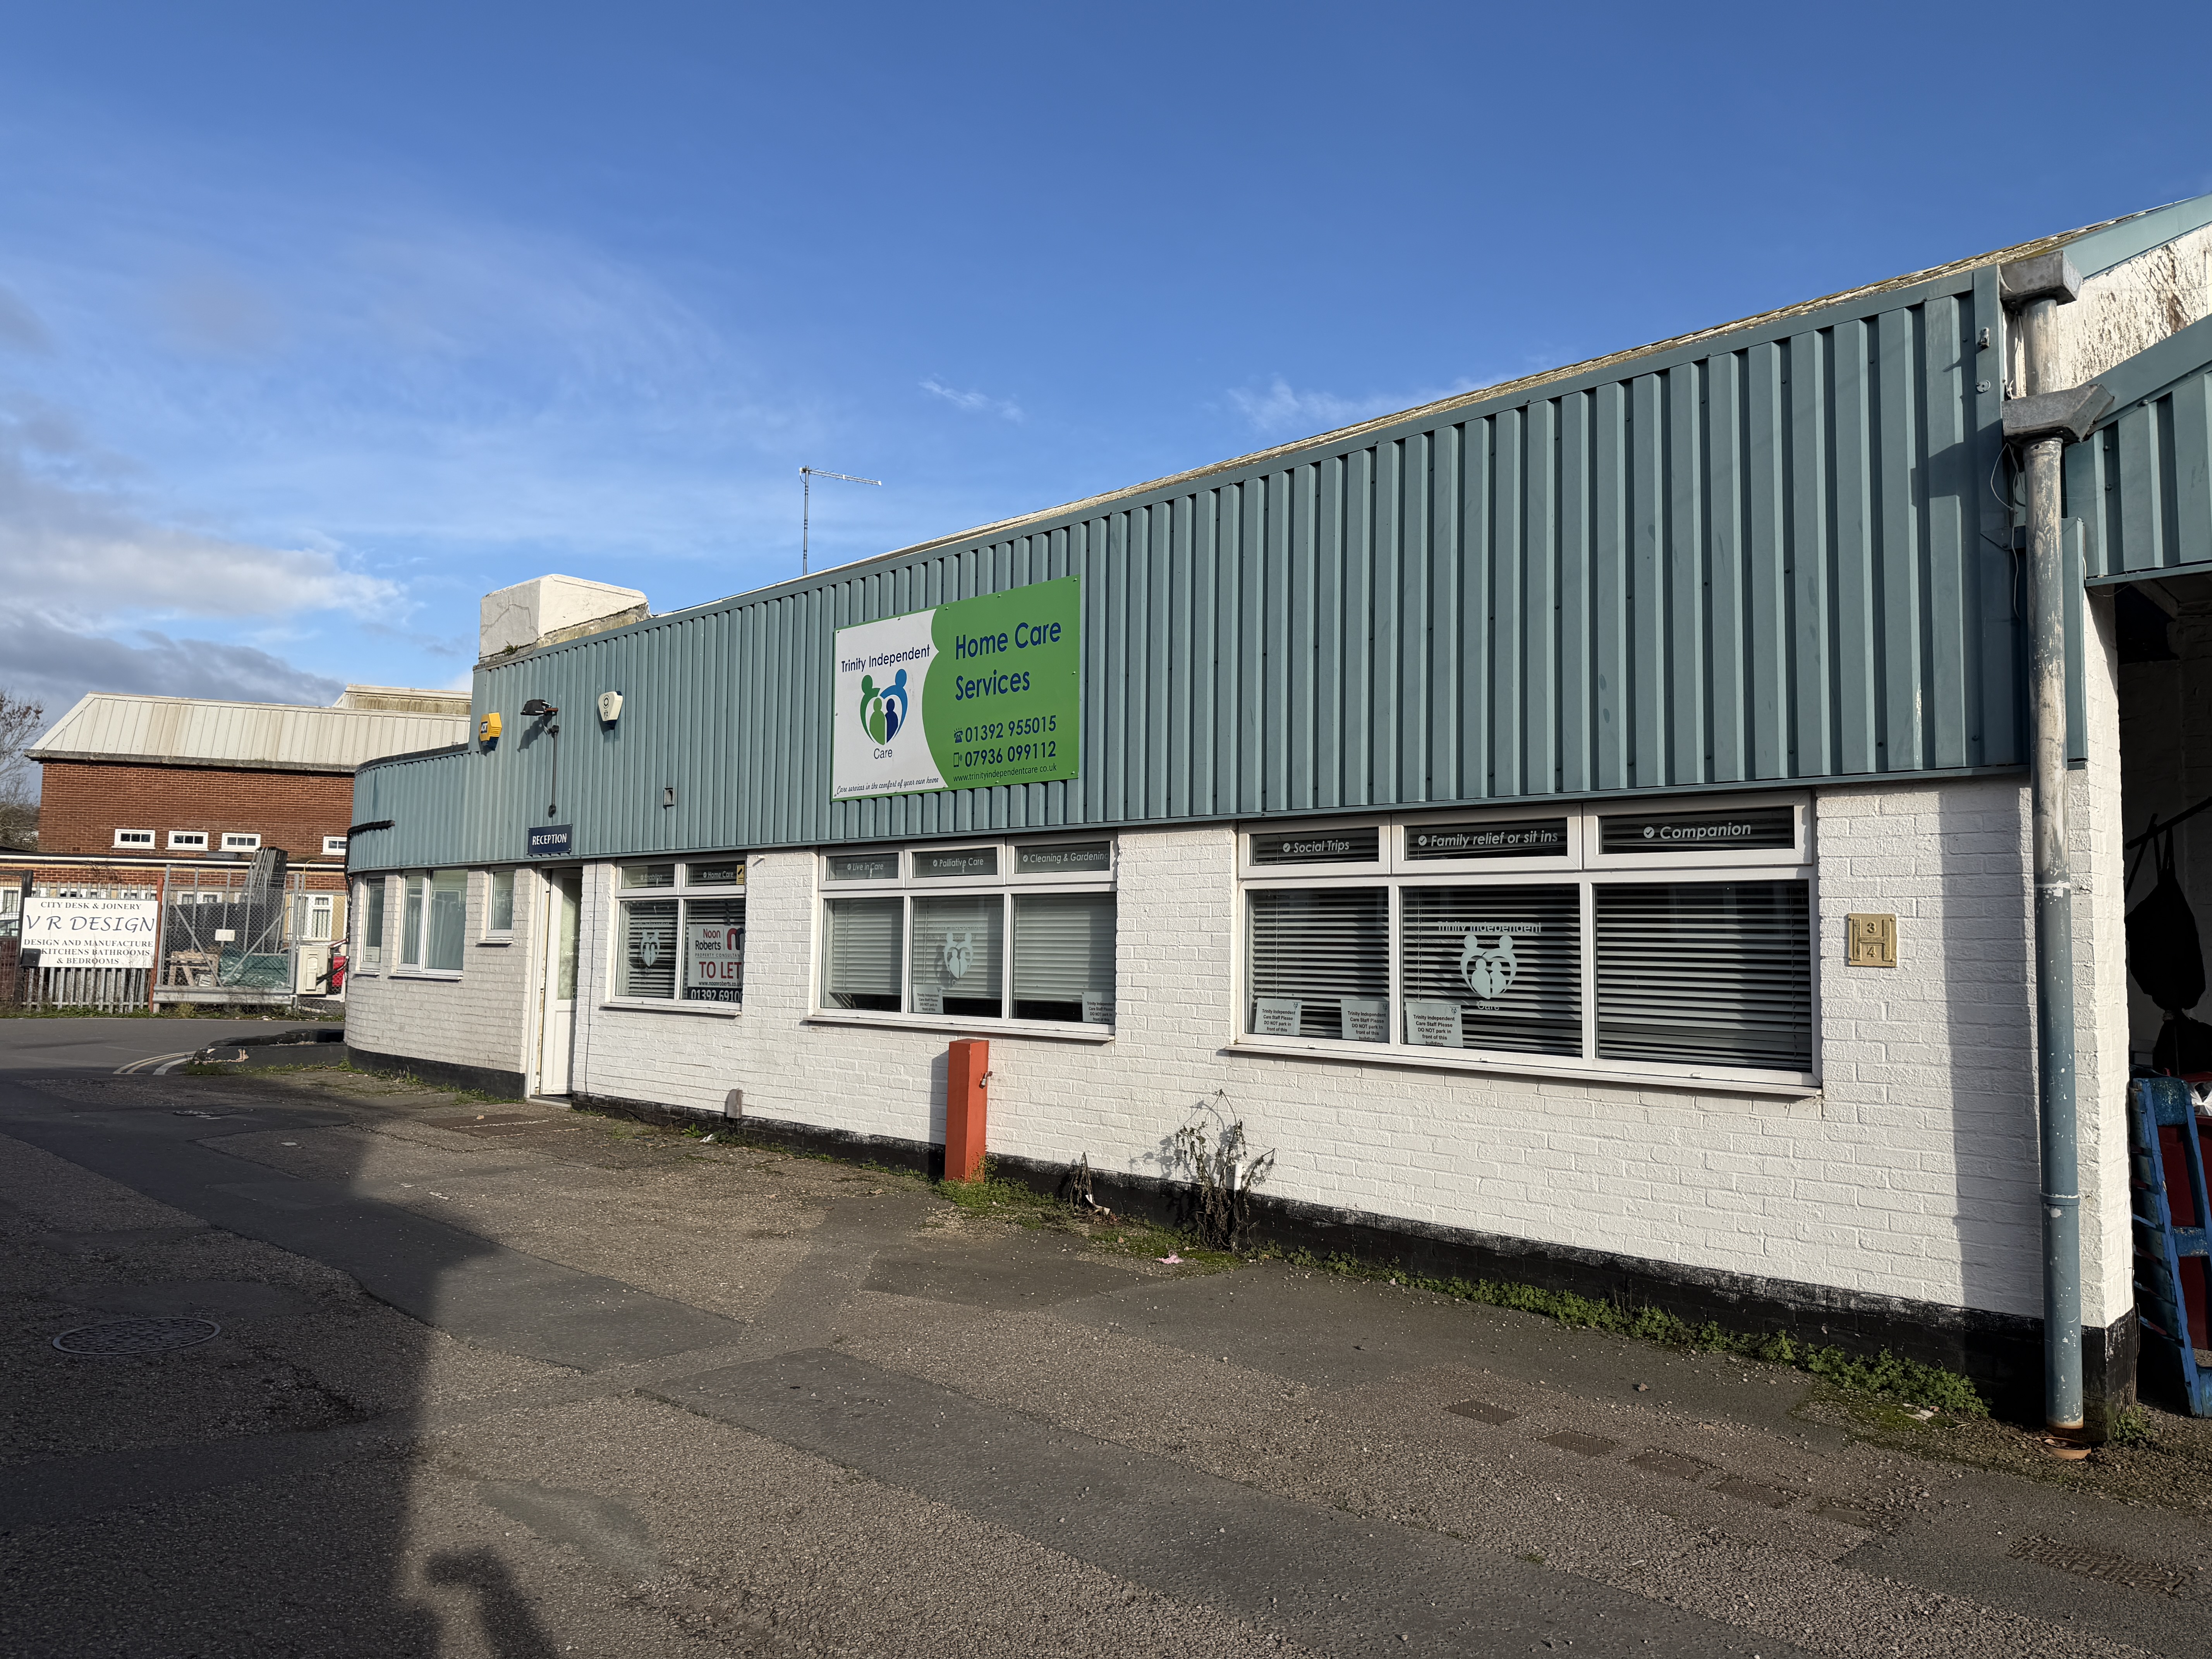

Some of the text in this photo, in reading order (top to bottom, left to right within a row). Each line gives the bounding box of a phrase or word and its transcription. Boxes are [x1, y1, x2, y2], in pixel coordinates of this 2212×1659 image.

[956, 622, 1061, 660] Home Care
[842, 644, 930, 673] Trinity Independent
[955, 669, 1030, 701] Services
[965, 715, 1056, 743] 01392 955015
[874, 748, 893, 759] Care
[965, 741, 1056, 767] 07936 099112
[837, 785, 847, 795] Care
[879, 780, 896, 790] comfort
[898, 779, 903, 788] of
[903, 780, 914, 788] your
[1660, 822, 1751, 840] Companion
[532, 833, 567, 845] RECEPTION
[1431, 830, 1558, 848] Family relief or sit ins
[1293, 840, 1350, 853] Social Trips
[939, 857, 984, 867] Palliative Care
[1030, 852, 1108, 864] Cleaning & Gardening
[26, 915, 155, 933] V R DESIGN
[1867, 922, 1877, 933] 3
[703, 928, 720, 938] Noon
[695, 940, 721, 950] Roberts
[1867, 946, 1877, 958] 4
[699, 961, 742, 979] TO LET
[691, 989, 716, 1000] 01392
